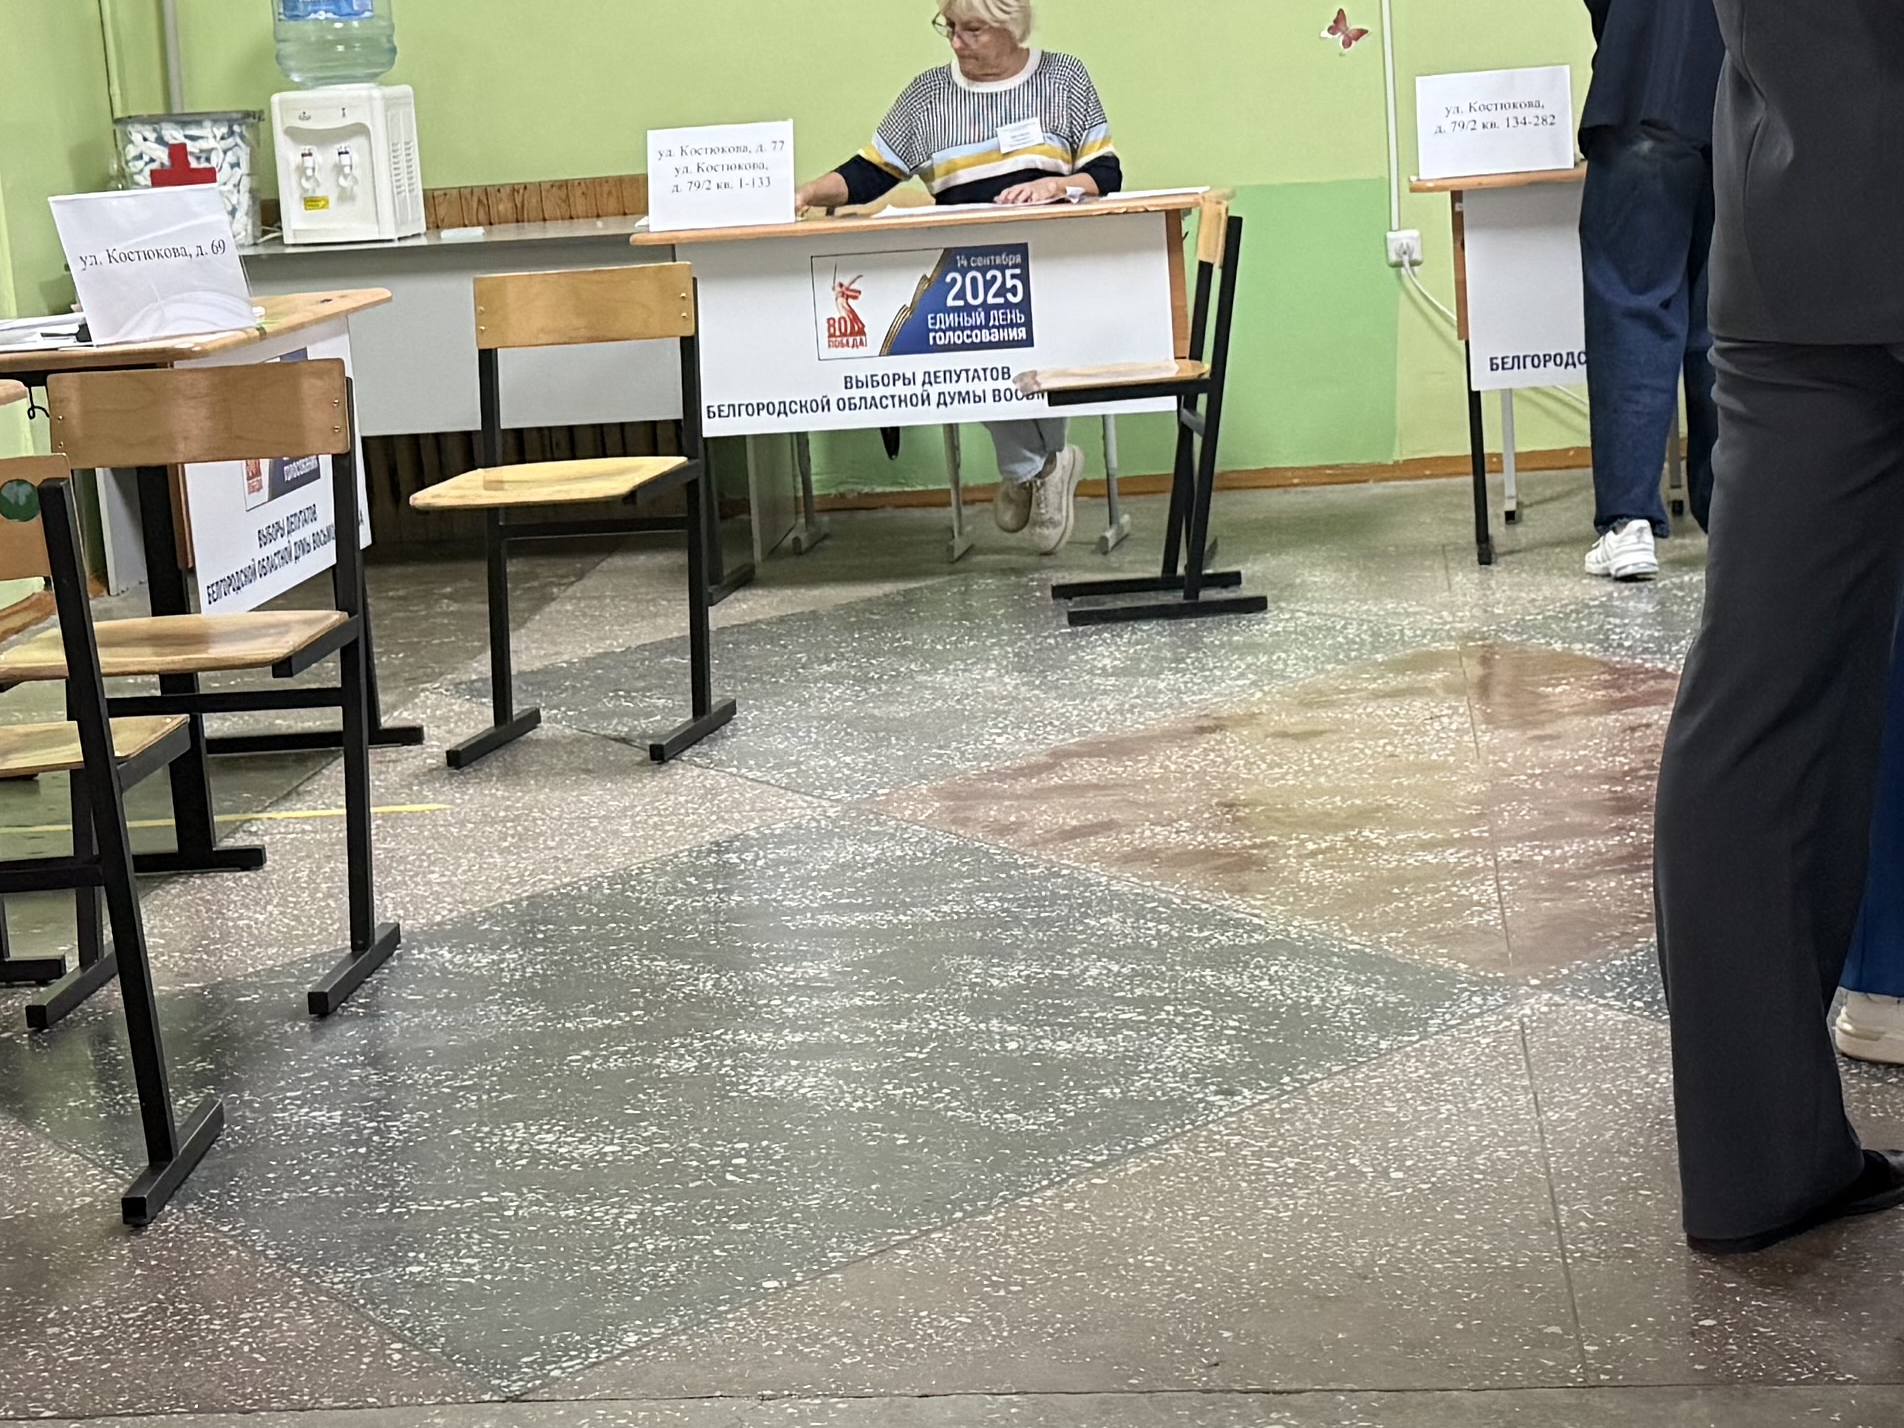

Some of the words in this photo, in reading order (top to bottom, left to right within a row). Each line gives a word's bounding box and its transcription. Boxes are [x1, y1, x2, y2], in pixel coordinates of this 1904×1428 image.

[1445, 105, 1463, 118] ул.
[1468, 99, 1544, 113] Костюкова,
[1451, 119, 1477, 133] 79/2
[1505, 114, 1556, 129] 134-282
[657, 149, 675, 161] ул.
[680, 144, 752, 157] Костюкова,
[771, 140, 785, 151] 77
[674, 166, 692, 177] ул.
[696, 162, 769, 174] Костюкова,
[687, 179, 712, 192] 79/2
[739, 176, 771, 189] 1-133
[79, 255, 103, 270] ул.
[105, 247, 192, 264] Костюкова,
[195, 246, 208, 258] д.
[211, 238, 226, 255] 69
[956, 255, 968, 267] 14
[970, 252, 1022, 268] сентября
[946, 268, 1024, 307] 2025
[927, 307, 985, 330] ЕДИНЫЙ
[989, 308, 1025, 326] ДЕНЬ
[843, 371, 916, 391] ВЫБОРЫ
[921, 366, 1011, 390] ДЕПУТАТОВ
[706, 395, 831, 420] БЕЛГОРОДСКОЙ
[837, 391, 931, 412] ОБЛАСТНОЙ
[936, 389, 986, 408] ДУМЫ
